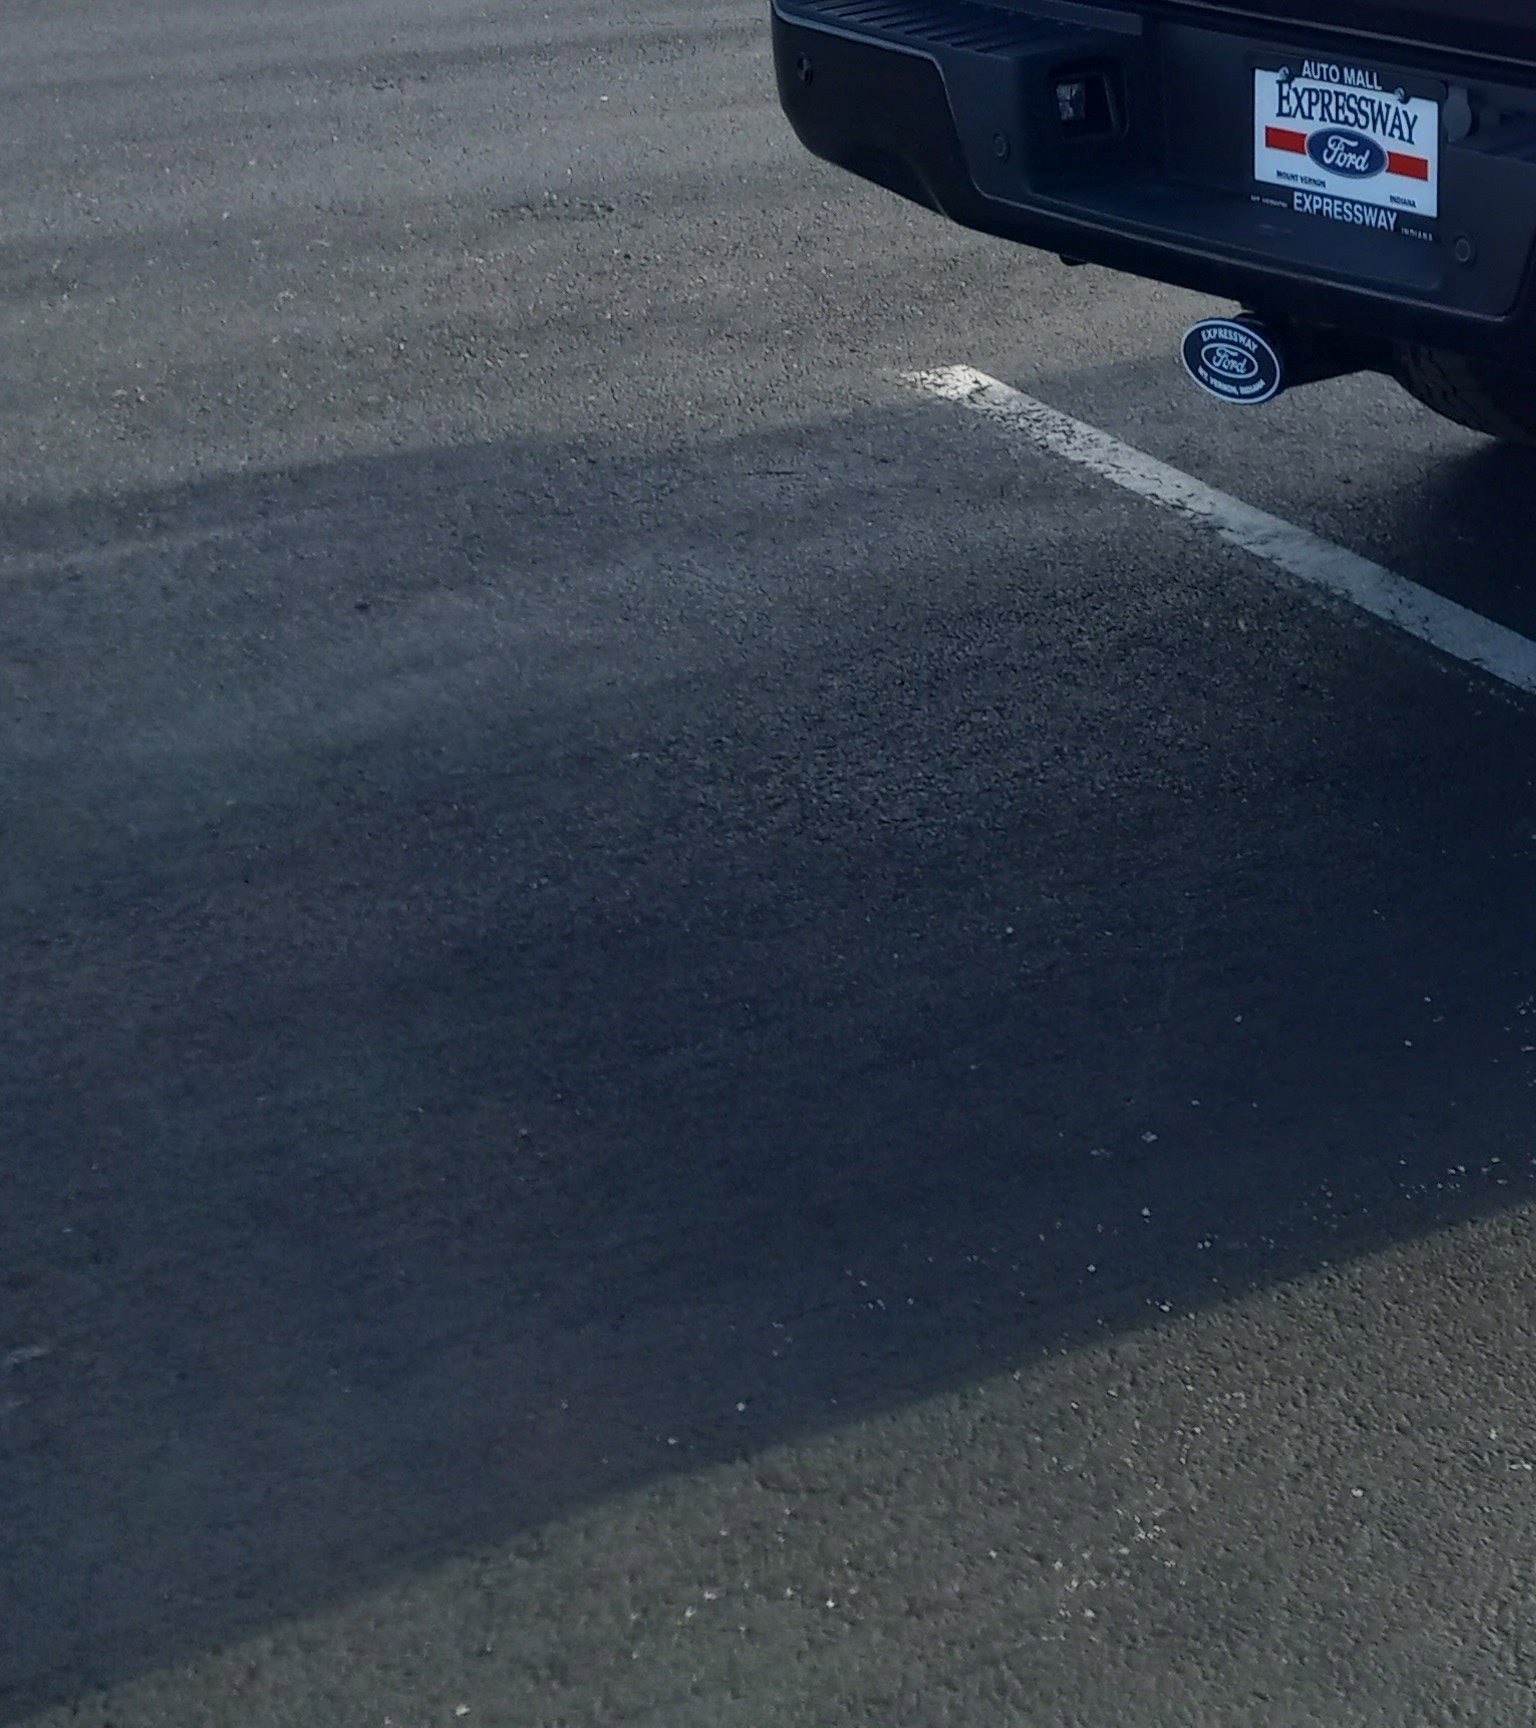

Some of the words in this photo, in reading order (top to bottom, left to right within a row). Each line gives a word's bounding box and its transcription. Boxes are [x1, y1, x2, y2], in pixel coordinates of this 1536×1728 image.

[1301, 60, 1340, 82] AUTO
[1343, 68, 1383, 91] MALL
[1275, 80, 1419, 145] EXPRESSWAY
[1323, 134, 1370, 172] Ford
[1276, 170, 1299, 184] MOUNT
[1300, 174, 1327, 189] VERNON
[1293, 191, 1398, 232] EXPRESSWAY
[1389, 195, 1417, 208] INDIANA
[1200, 327, 1258, 354] EXPRESSWAY
[1212, 347, 1248, 374] Ford
[1239, 378, 1266, 395] INDIANA
